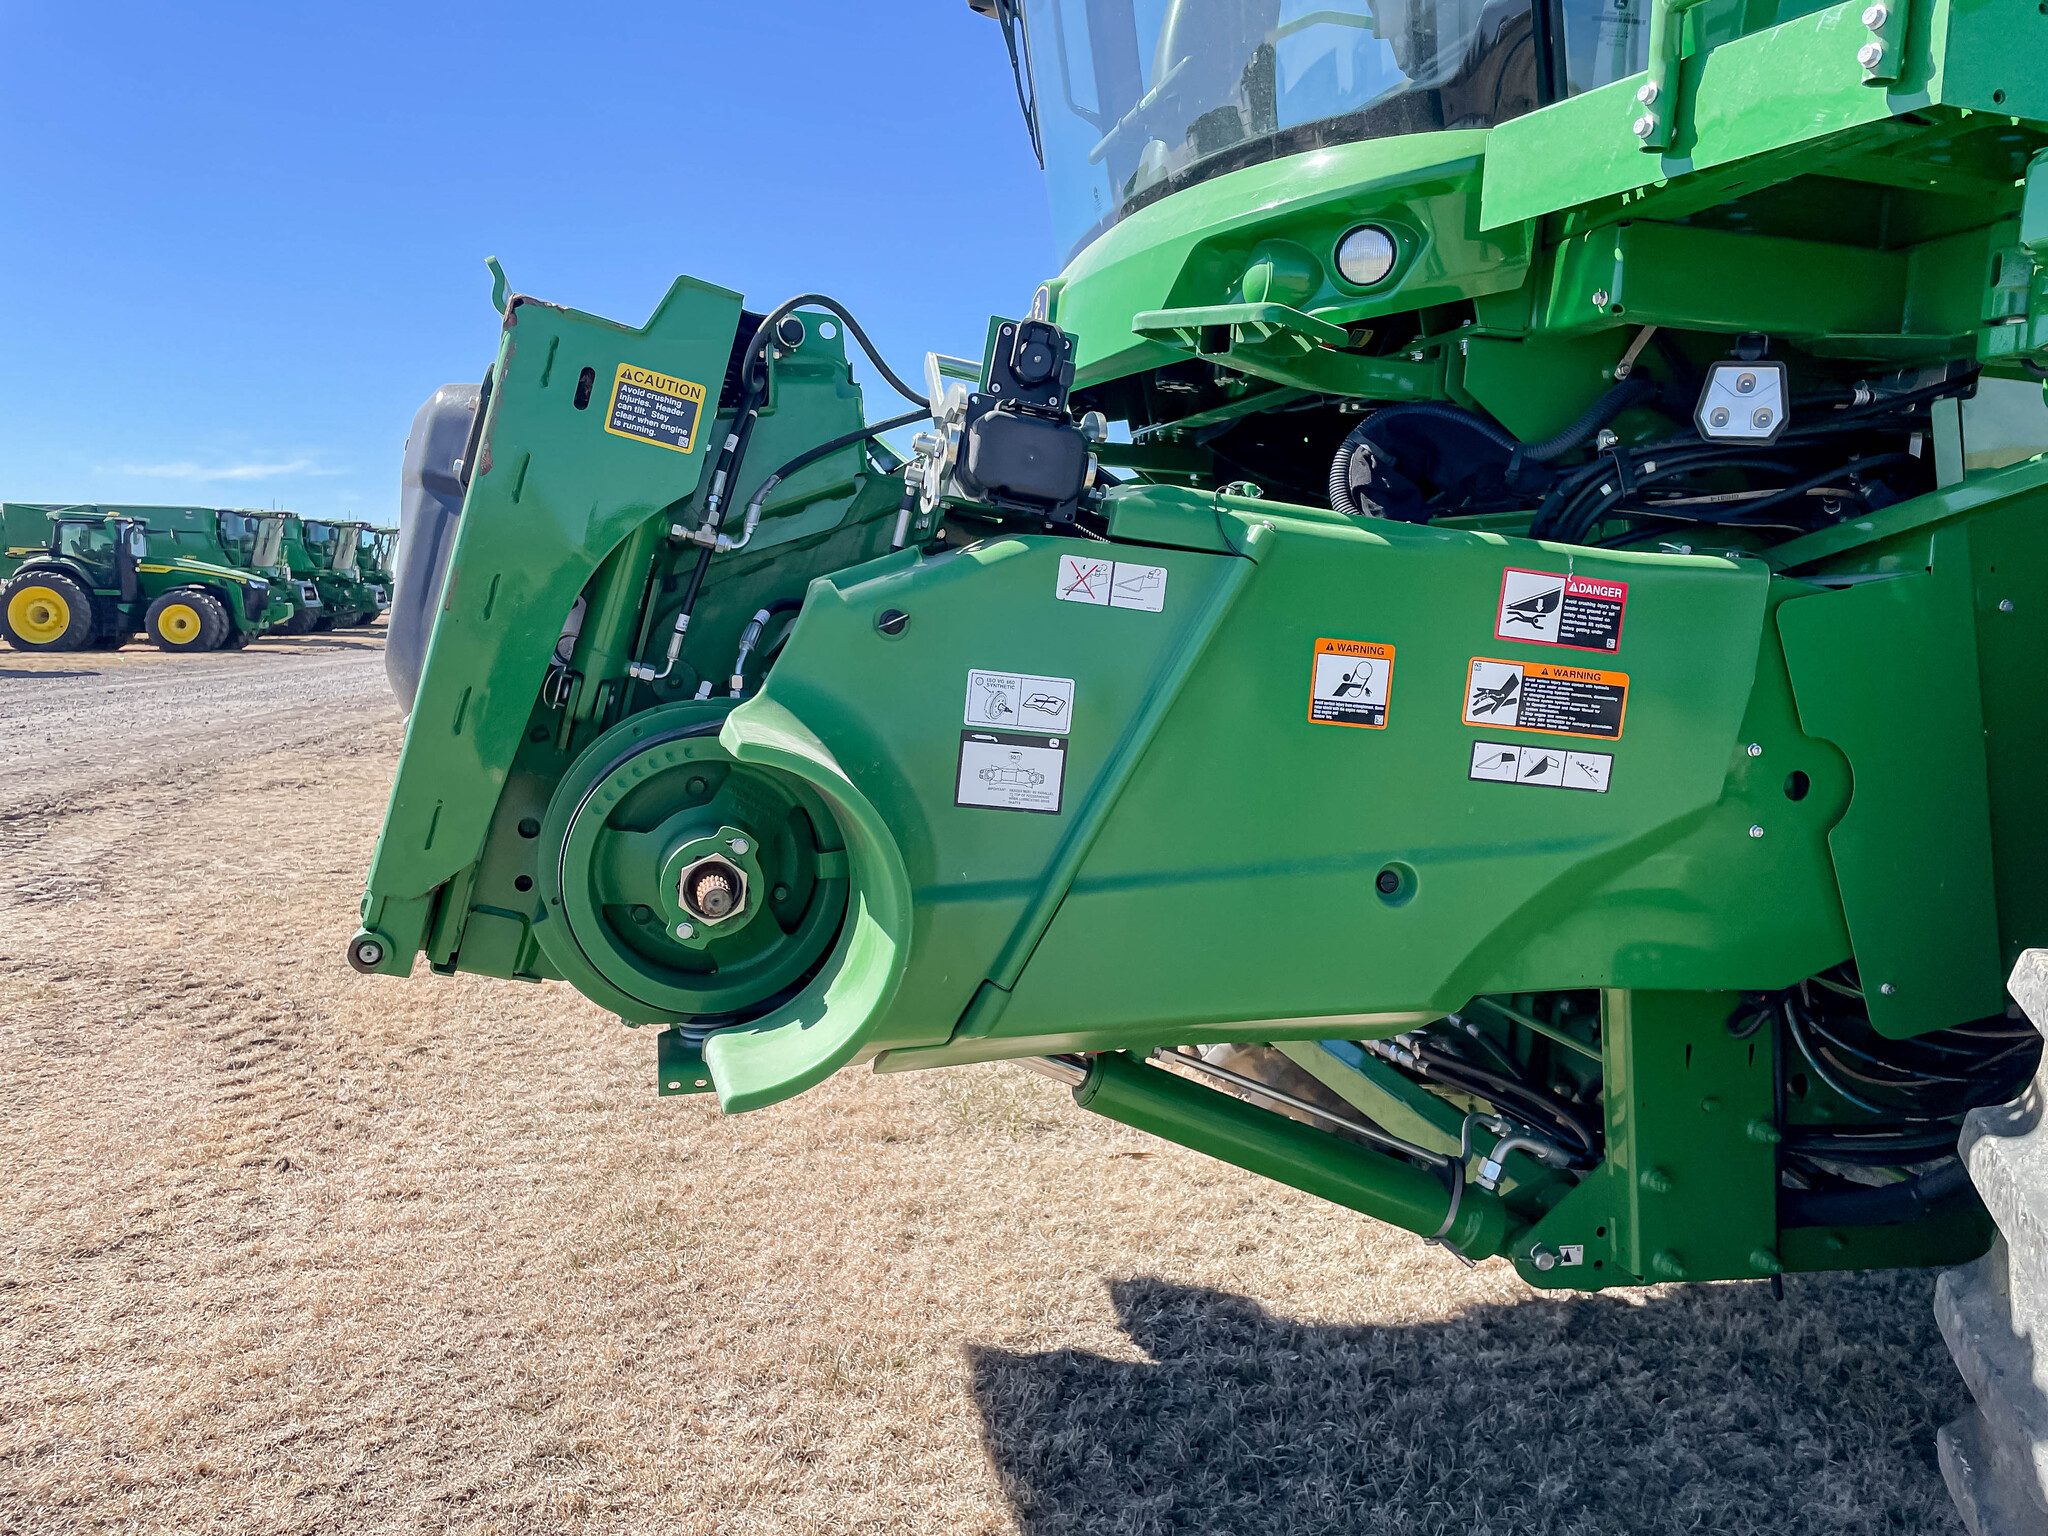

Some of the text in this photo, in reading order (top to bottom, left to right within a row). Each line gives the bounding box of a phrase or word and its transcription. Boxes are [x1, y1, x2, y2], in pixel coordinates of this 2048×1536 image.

[634, 372, 700, 399] CAUTION
[621, 385, 682, 408] Avoid crushing
[620, 393, 685, 416] injuries. Header
[634, 407, 646, 415] tilt.
[651, 411, 669, 422] Stay
[616, 411, 688, 435] clear when engine
[623, 422, 656, 436] running.
[1579, 584, 1622, 598] DANGER
[1337, 643, 1384, 655] WARNING
[1554, 669, 1601, 680] WARNING
